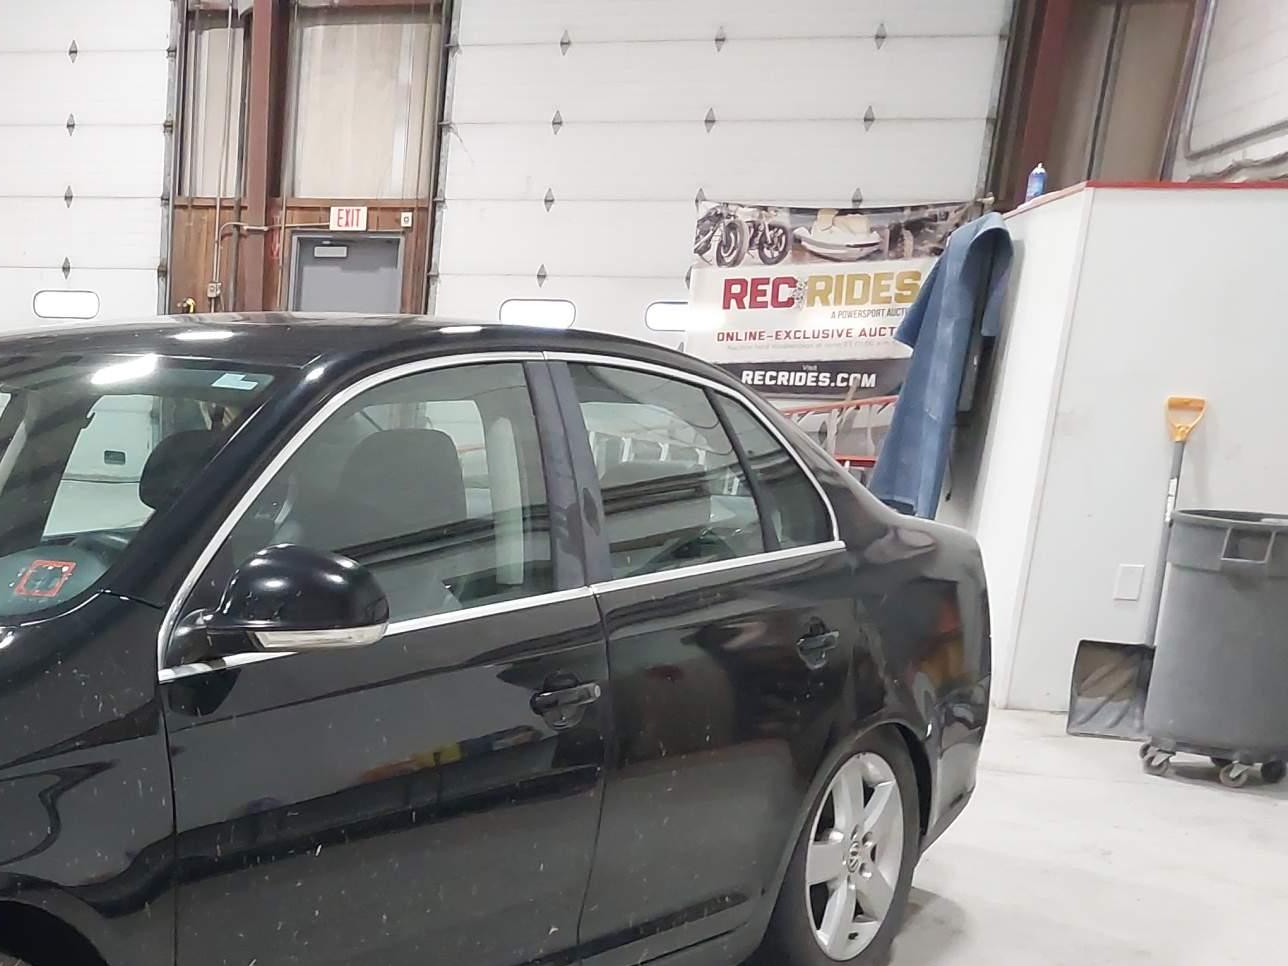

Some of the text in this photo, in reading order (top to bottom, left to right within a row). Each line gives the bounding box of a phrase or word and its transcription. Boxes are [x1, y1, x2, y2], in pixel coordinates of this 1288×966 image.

[337, 208, 361, 227] EXIT
[722, 270, 922, 310] REC RIDES
[837, 308, 885, 319] POWERSPORT
[716, 328, 853, 342] ONLINE-EXCLUSIVE
